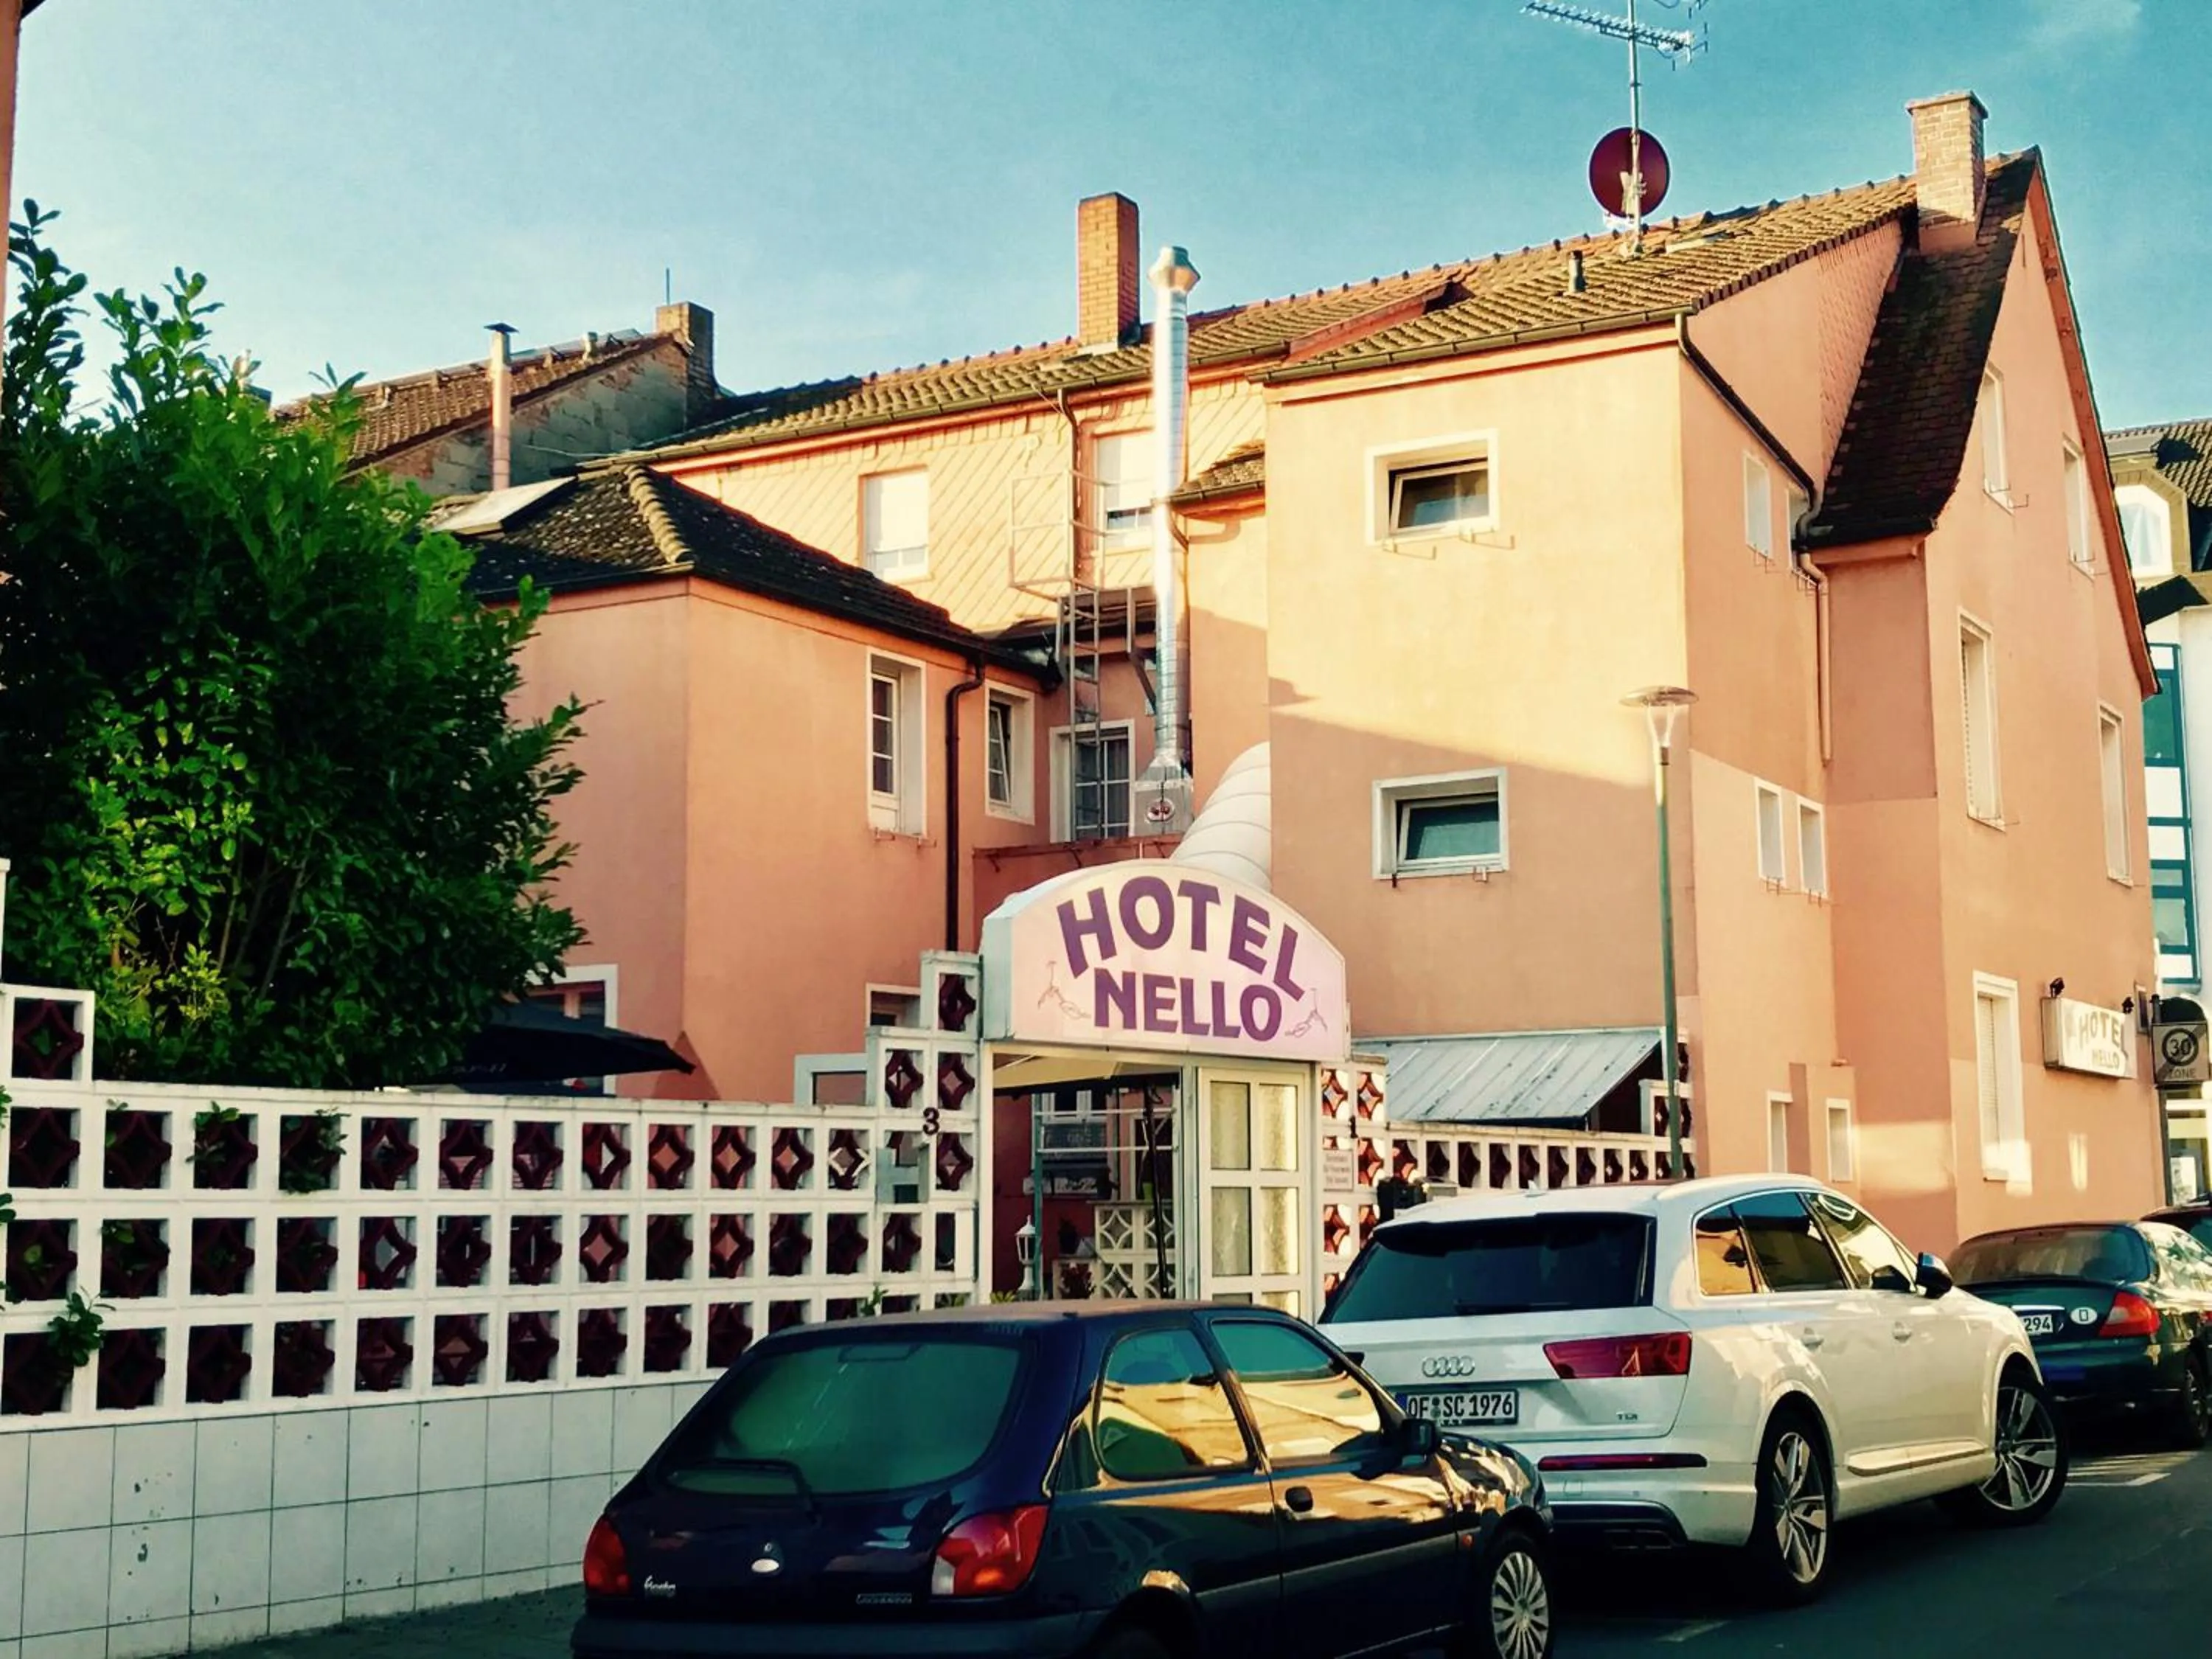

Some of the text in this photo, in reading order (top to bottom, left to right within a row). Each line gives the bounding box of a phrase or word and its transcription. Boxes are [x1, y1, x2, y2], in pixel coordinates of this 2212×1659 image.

[1056, 875, 1305, 1002] HOTEL
[1093, 967, 1282, 1042] NELLO
[2079, 1011, 2129, 1060] HOTEL
[2170, 1038, 2191, 1057] 30
[2168, 1067, 2197, 1079] ZONE
[922, 1107, 940, 1136] 3
[2023, 1316, 2051, 1332] 294
[1408, 1393, 1513, 1418] OF SC 1976
